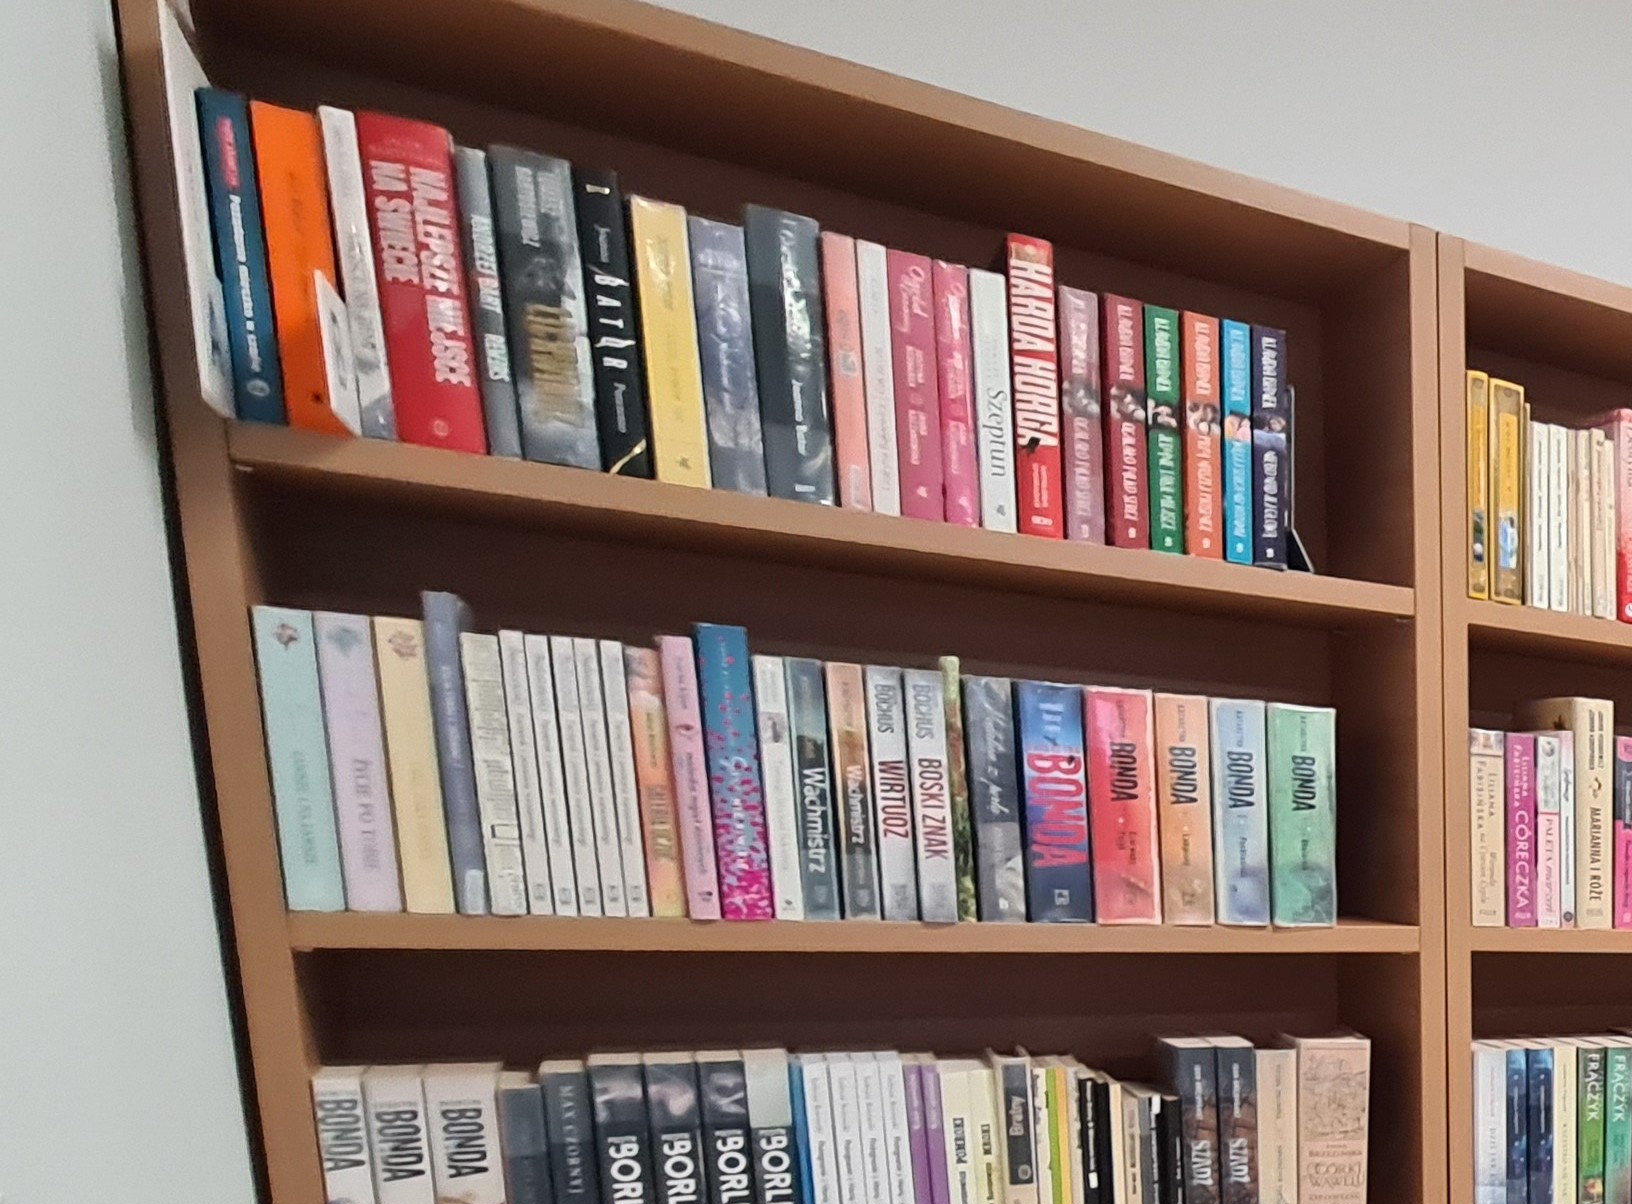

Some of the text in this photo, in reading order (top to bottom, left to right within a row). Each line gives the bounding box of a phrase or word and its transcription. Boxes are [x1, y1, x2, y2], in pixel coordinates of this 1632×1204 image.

[370, 161, 406, 191] NA
[410, 167, 471, 387] NAJLEPSZE MIEJSCE
[1009, 259, 1055, 352] HARDA
[592, 272, 636, 369] BATOR
[983, 388, 1008, 478] Szeptun
[874, 684, 909, 840] BOCHUS WIRTUOZ
[912, 683, 949, 861] BOCHUS BOSKI ZNAK
[1109, 742, 1139, 803] BONDA
[1168, 746, 1198, 805] BONDA
[1226, 751, 1255, 809] BONDA
[1291, 755, 1317, 813] BONDA
[358, 804, 378, 825] PO
[802, 767, 828, 874] Wachmistrz
[847, 765, 865, 845] Wachmistrz
[1026, 752, 1087, 869] BONDA
[1589, 807, 1602, 864] MARIANNA
[1516, 810, 1532, 909] CÓRECZKA
[1589, 875, 1603, 901] RÓŻE
[1009, 1095, 1026, 1136] Bratny
[1584, 1053, 1600, 1122] FRĄCZYK
[1611, 1054, 1626, 1123] FRĄCZYK
[319, 1100, 367, 1172] BONDA
[375, 1110, 426, 1182] BONDA
[441, 1107, 489, 1179] BONDA
[558, 1085, 585, 1193] MAX CZORNYJ
